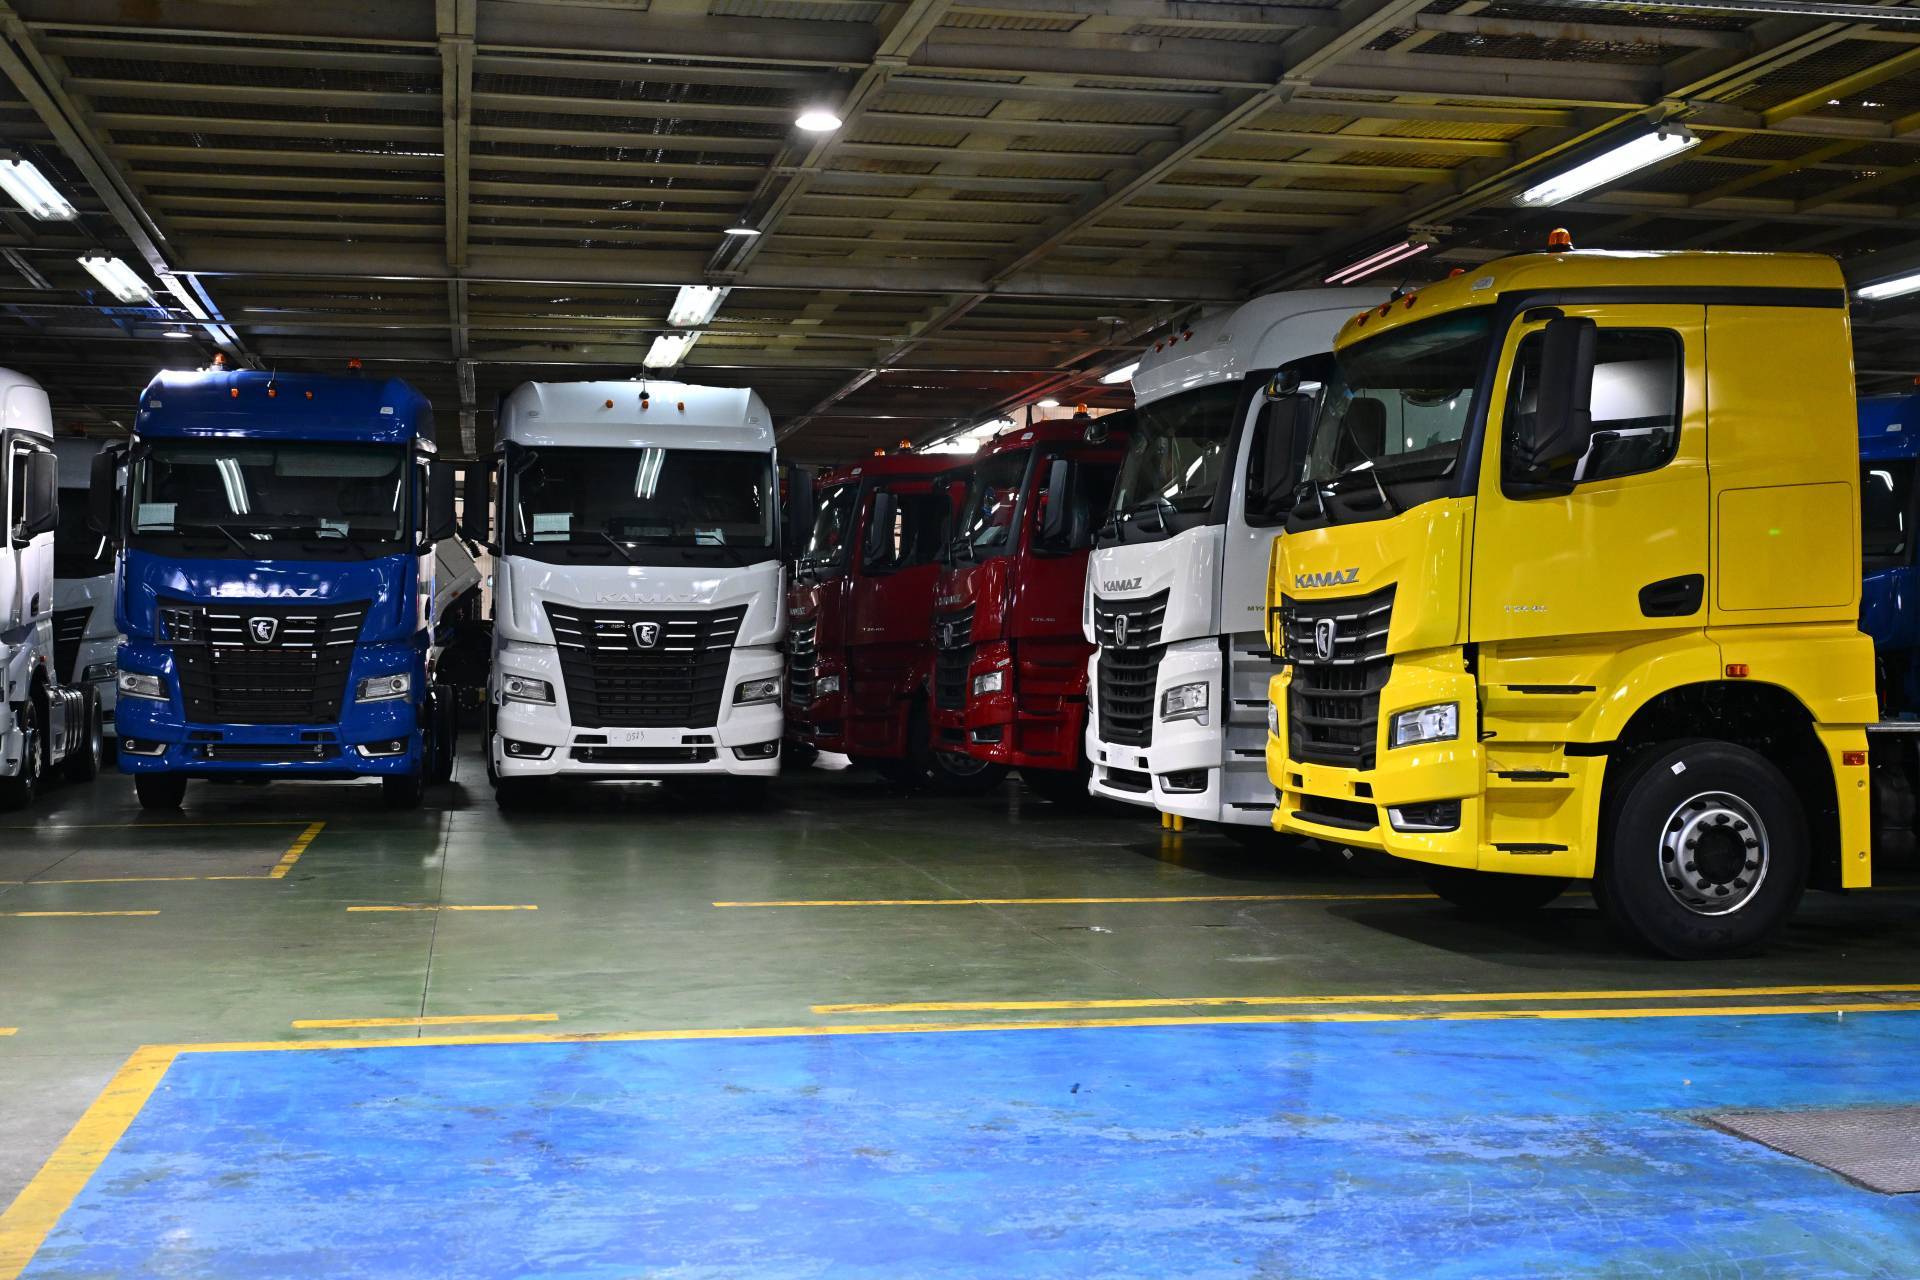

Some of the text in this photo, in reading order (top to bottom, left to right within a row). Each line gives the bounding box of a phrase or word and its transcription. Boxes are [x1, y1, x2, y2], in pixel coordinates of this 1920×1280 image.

[1103, 576, 1142, 591] KAMAZ
[1294, 567, 1360, 588] KAMAZ
[595, 591, 704, 604] KAMAZ
